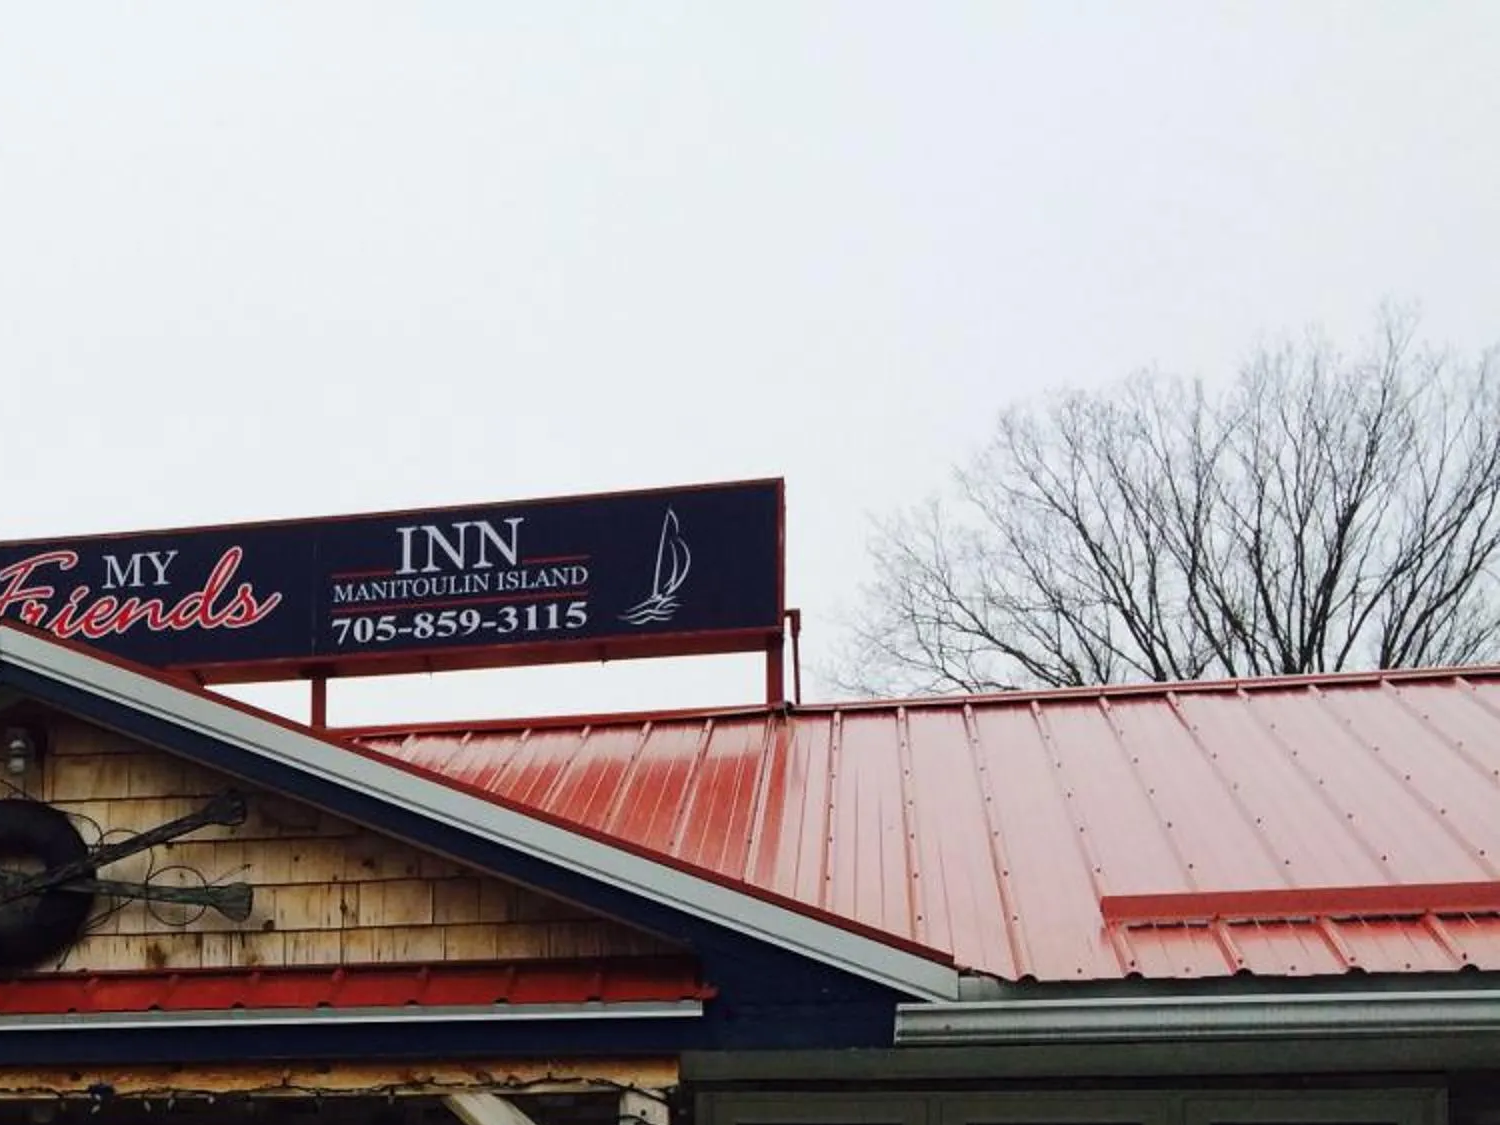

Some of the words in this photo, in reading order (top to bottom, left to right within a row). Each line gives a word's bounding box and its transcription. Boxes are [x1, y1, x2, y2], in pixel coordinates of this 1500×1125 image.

[395, 517, 524, 574] INN
[102, 549, 180, 589] MY
[333, 575, 490, 603] MANITOULIN
[497, 567, 589, 591] ISLAND
[331, 602, 588, 645] 705-859-3115
